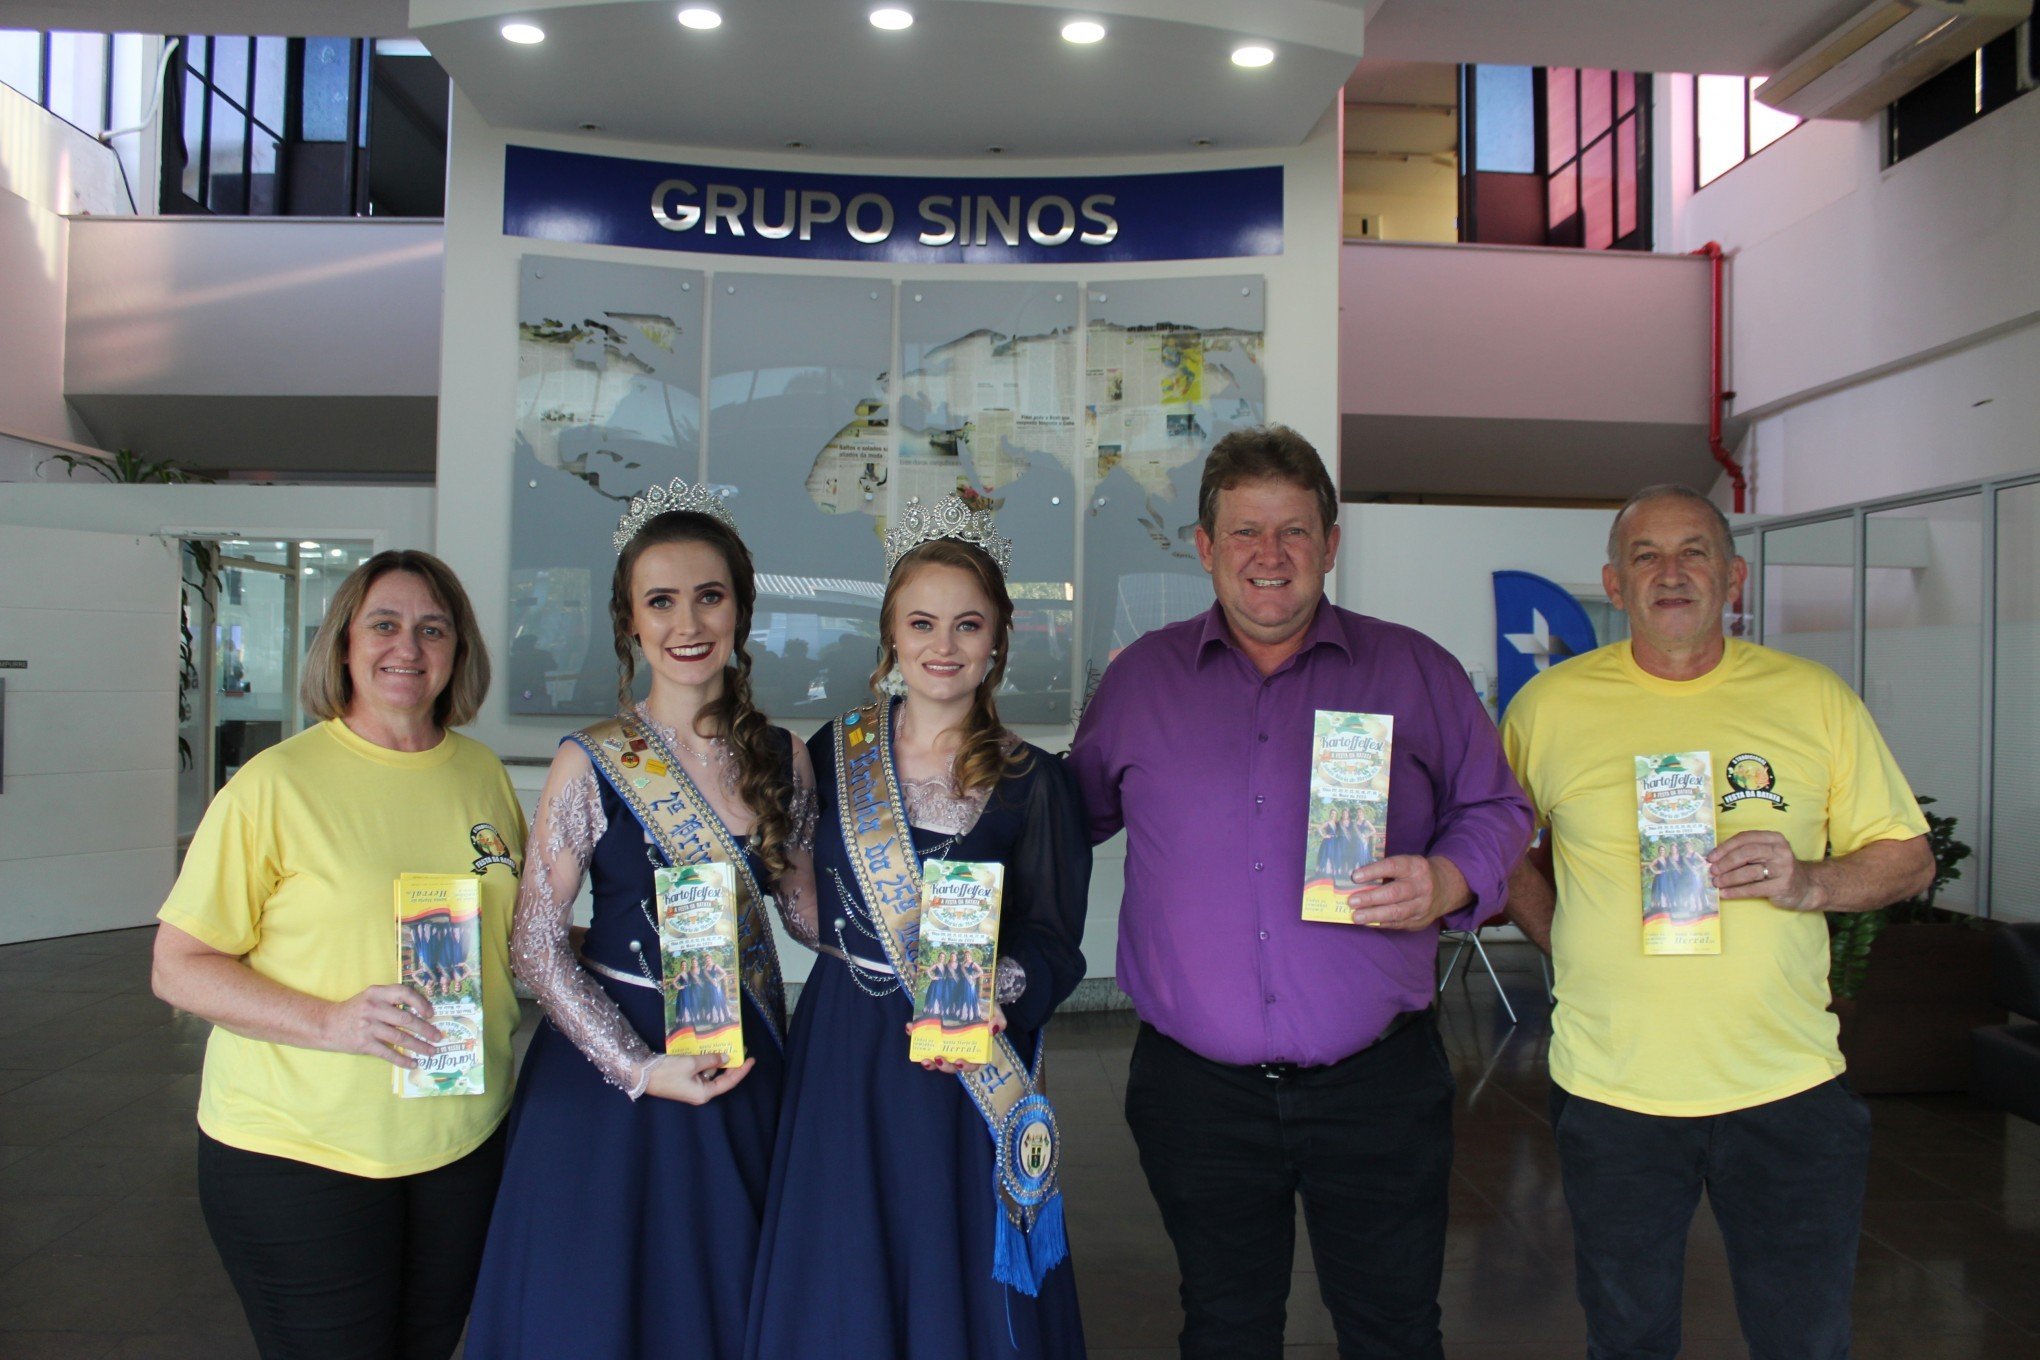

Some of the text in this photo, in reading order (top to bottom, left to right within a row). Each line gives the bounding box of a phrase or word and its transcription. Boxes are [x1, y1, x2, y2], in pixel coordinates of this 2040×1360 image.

[651, 179, 1119, 247] GRUPO SINOS
[1320, 735, 1383, 751] Kartoffelfest
[849, 746, 890, 836] Rainha
[1641, 774, 1703, 790] Kartoffelfest
[1724, 790, 1781, 803] FESTA DA BATATA
[669, 814, 712, 865] Pri
[865, 836, 895, 874] da
[663, 886, 722, 905] Kartoffelfest
[931, 884, 992, 899] Kartoffelfest
[416, 1053, 478, 1071] Kartoffelfe
